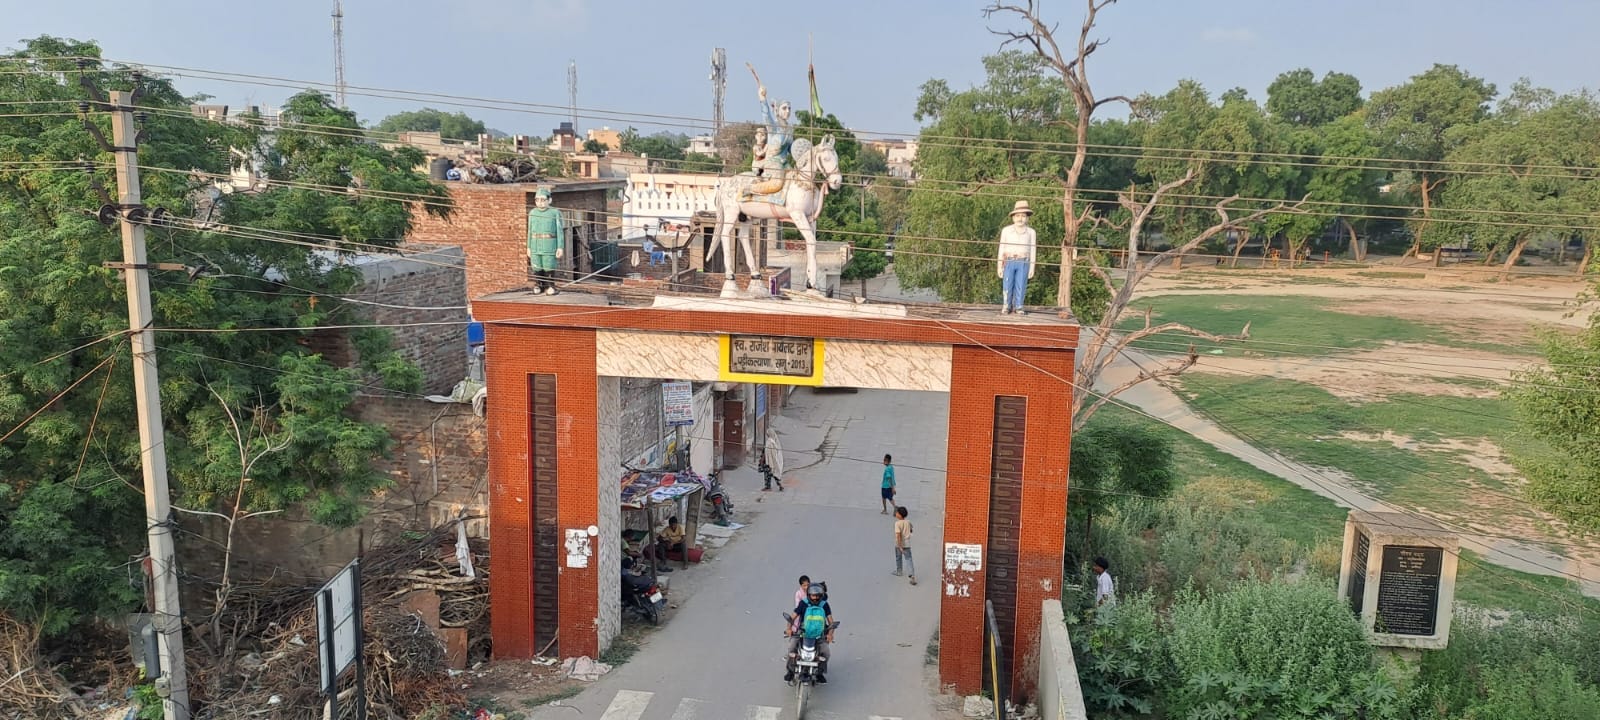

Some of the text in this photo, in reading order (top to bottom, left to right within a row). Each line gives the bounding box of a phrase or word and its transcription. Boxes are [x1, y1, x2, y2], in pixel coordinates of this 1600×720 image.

[749, 337, 769, 352] राजेश
[796, 343, 808, 355] द्वार
[791, 359, 806, 369] 2013
